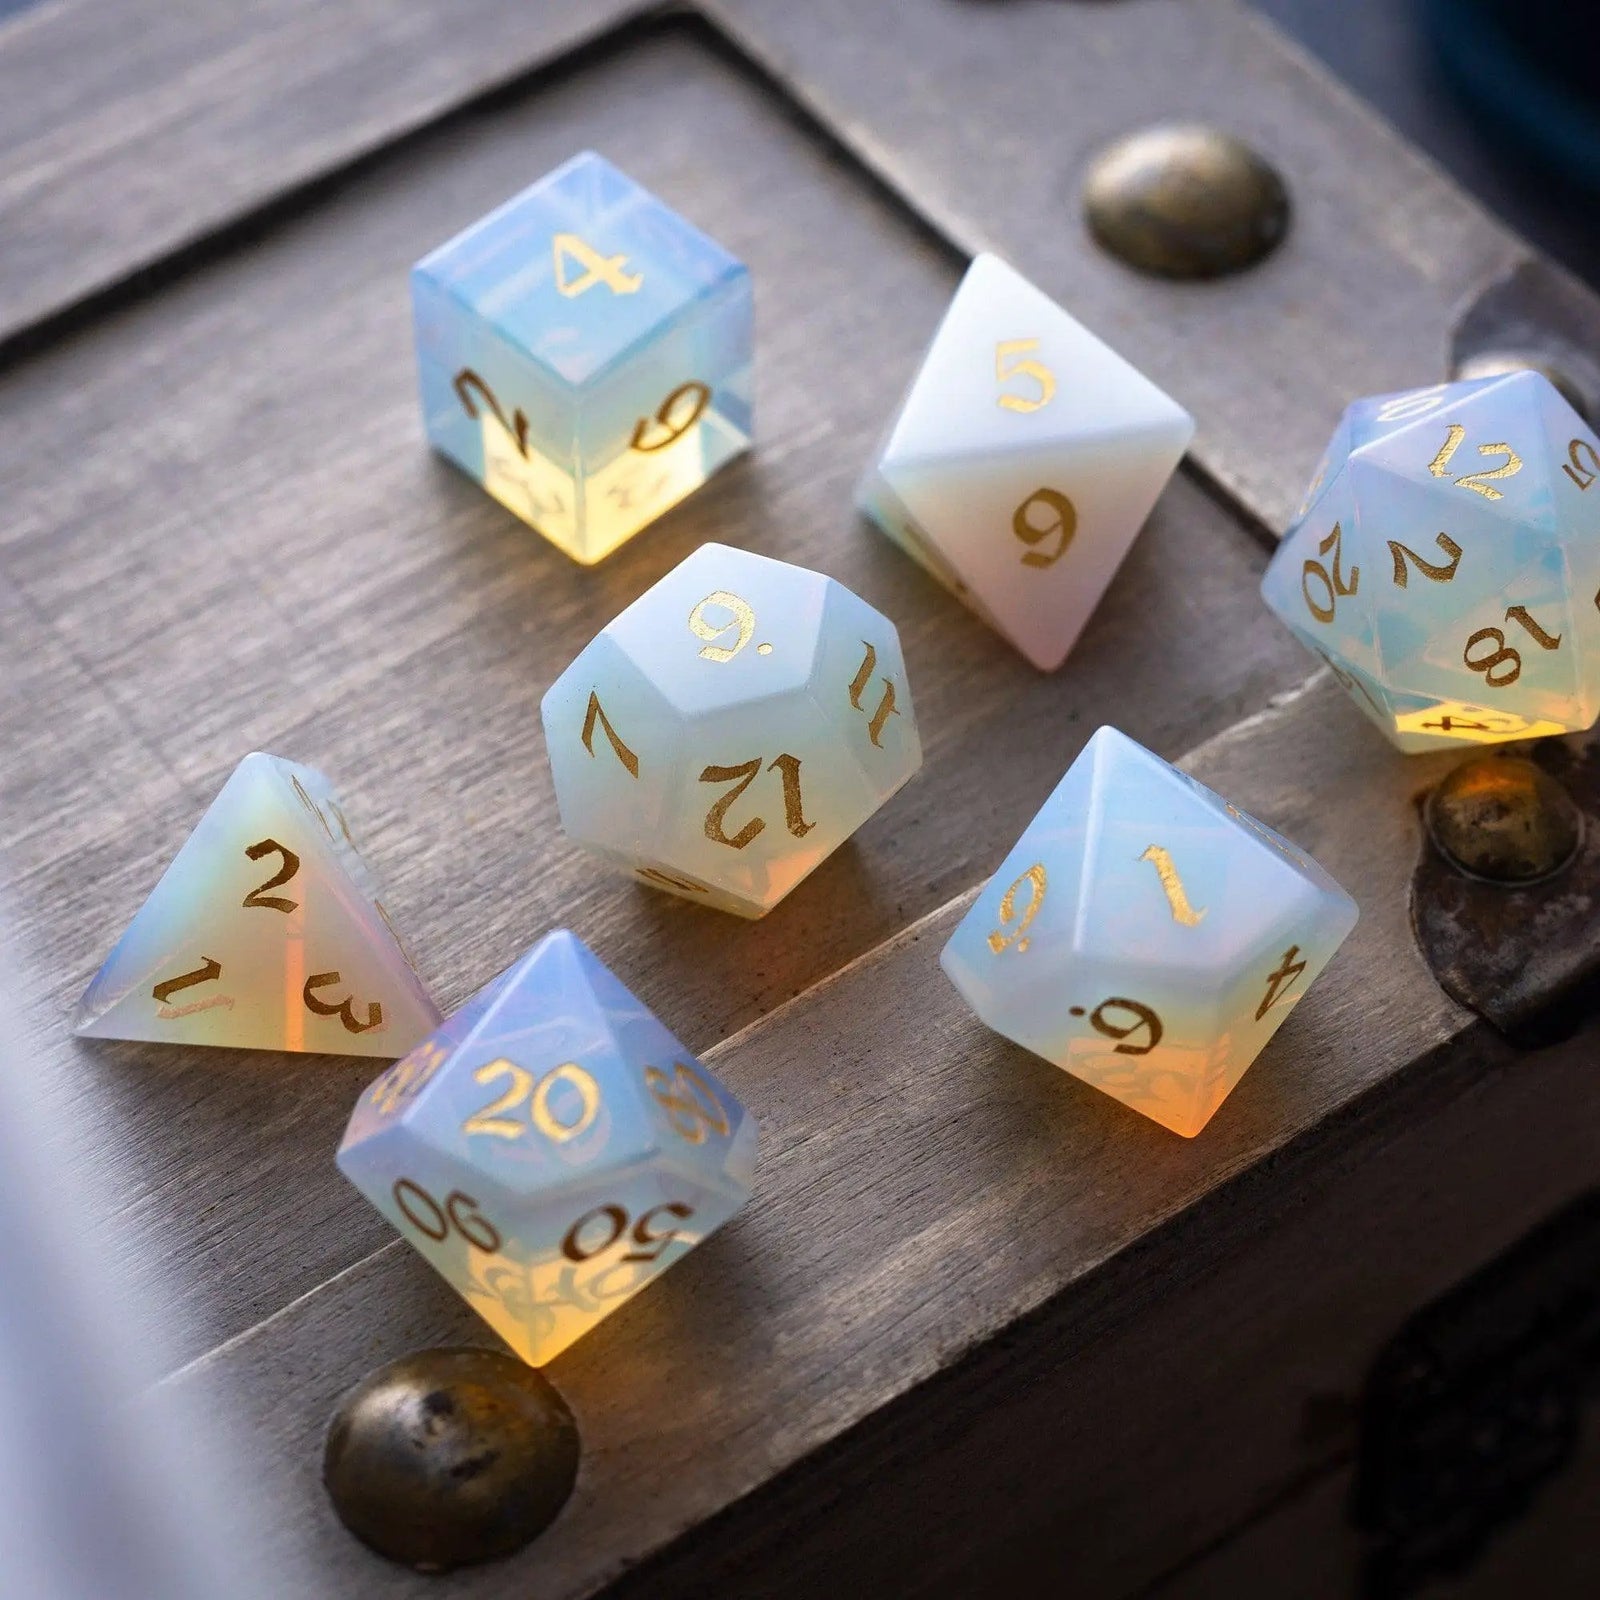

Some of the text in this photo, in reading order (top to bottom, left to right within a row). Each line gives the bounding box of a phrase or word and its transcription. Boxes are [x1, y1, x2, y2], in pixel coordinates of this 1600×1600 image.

[553, 234, 644, 299] 4
[995, 337, 1057, 414] 5
[1427, 424, 1523, 500] 12
[1302, 521, 1360, 623] 20
[1387, 531, 1463, 589] 2
[1463, 605, 1562, 687] 18
[699, 753, 816, 849] 12
[242, 838, 300, 913] 2
[1137, 844, 1208, 927] 1
[152, 956, 222, 1004] 1
[303, 971, 382, 1034] 3
[464, 1058, 600, 1143] 20
[560, 1202, 695, 1264] 50
